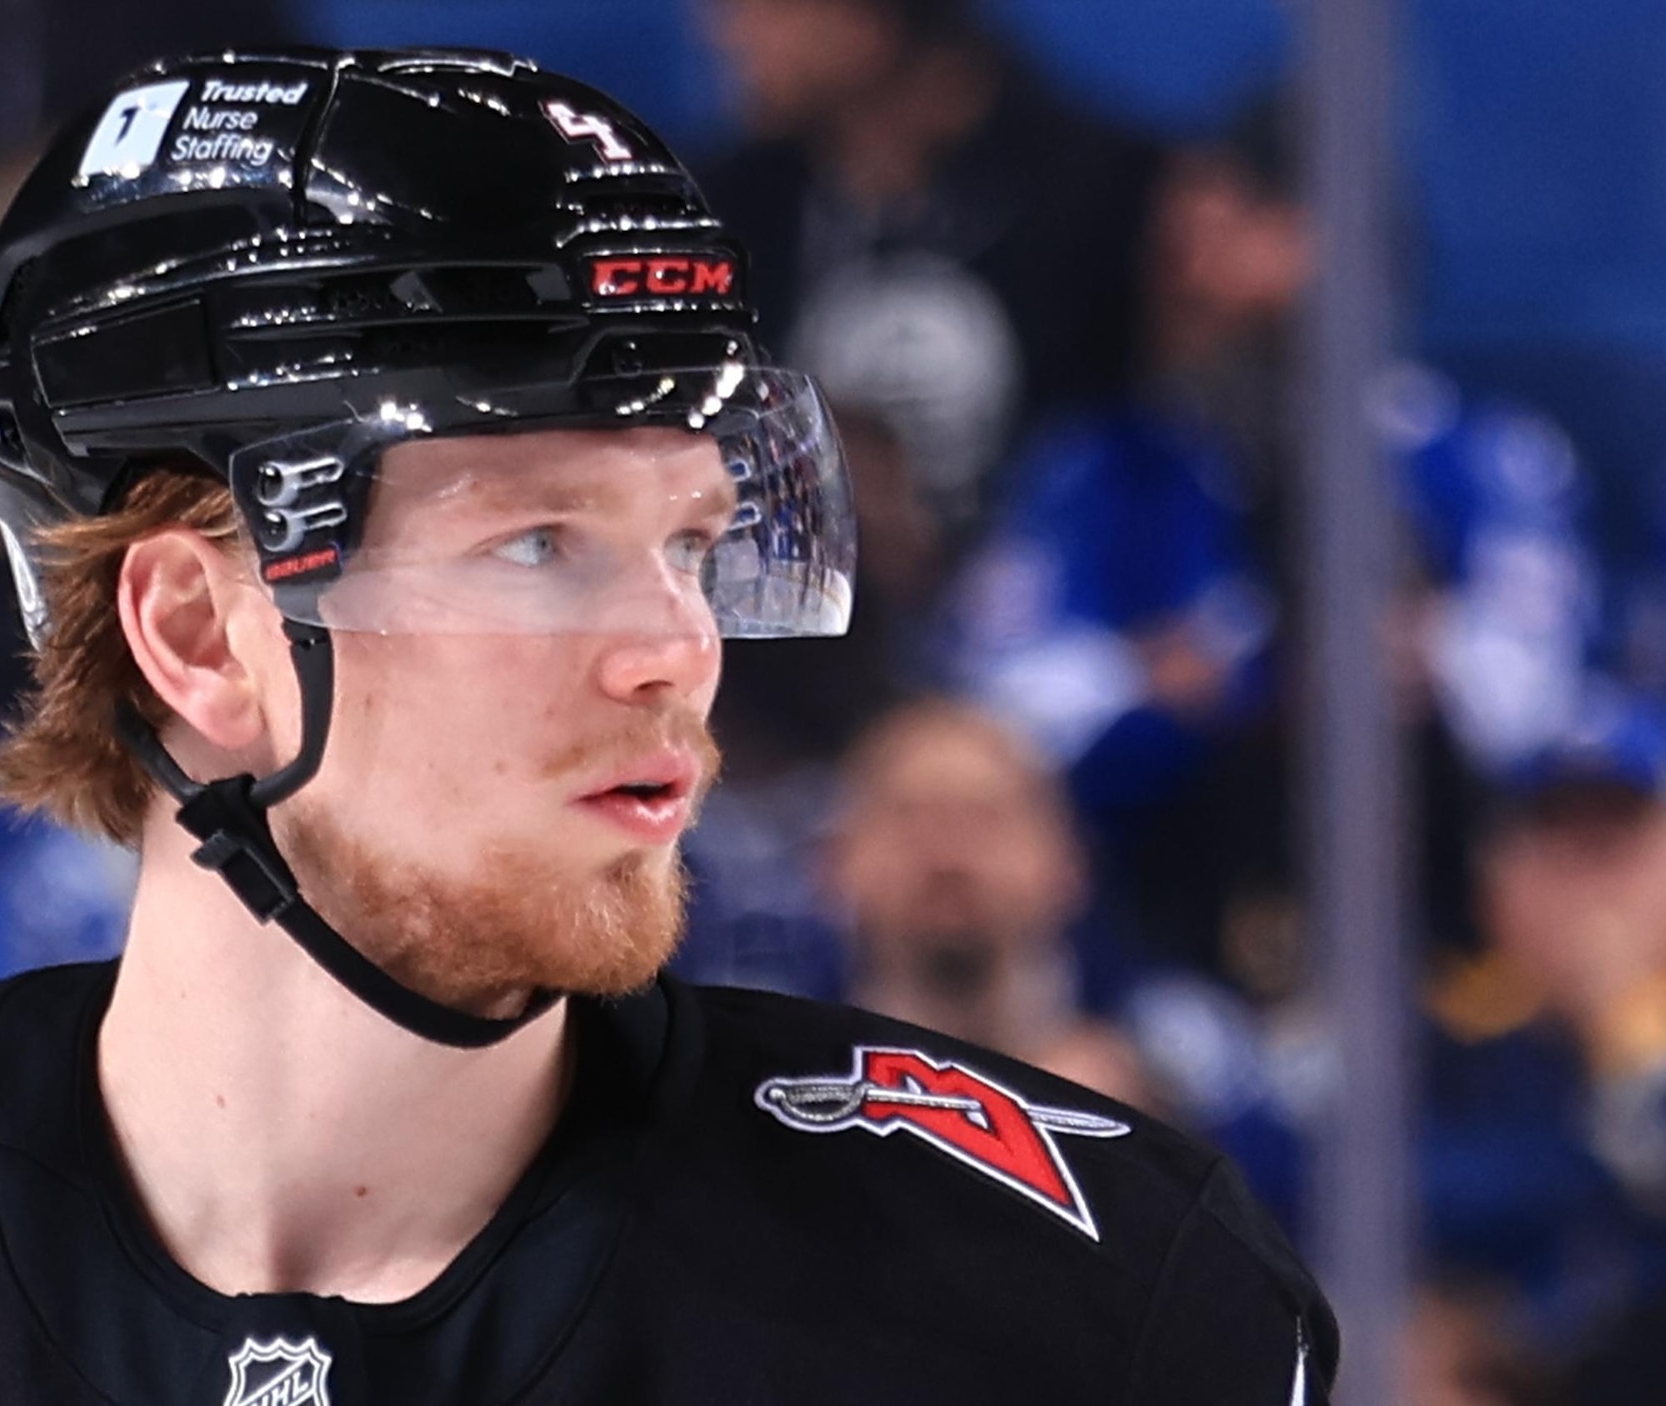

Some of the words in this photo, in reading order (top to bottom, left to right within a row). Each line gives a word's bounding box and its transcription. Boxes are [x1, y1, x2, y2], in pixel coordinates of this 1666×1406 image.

[201, 79, 308, 104] Trusted
[183, 106, 258, 130] Nurse
[541, 101, 634, 164] 4
[171, 133, 274, 166] Staffing
[592, 260, 733, 295] CCM
